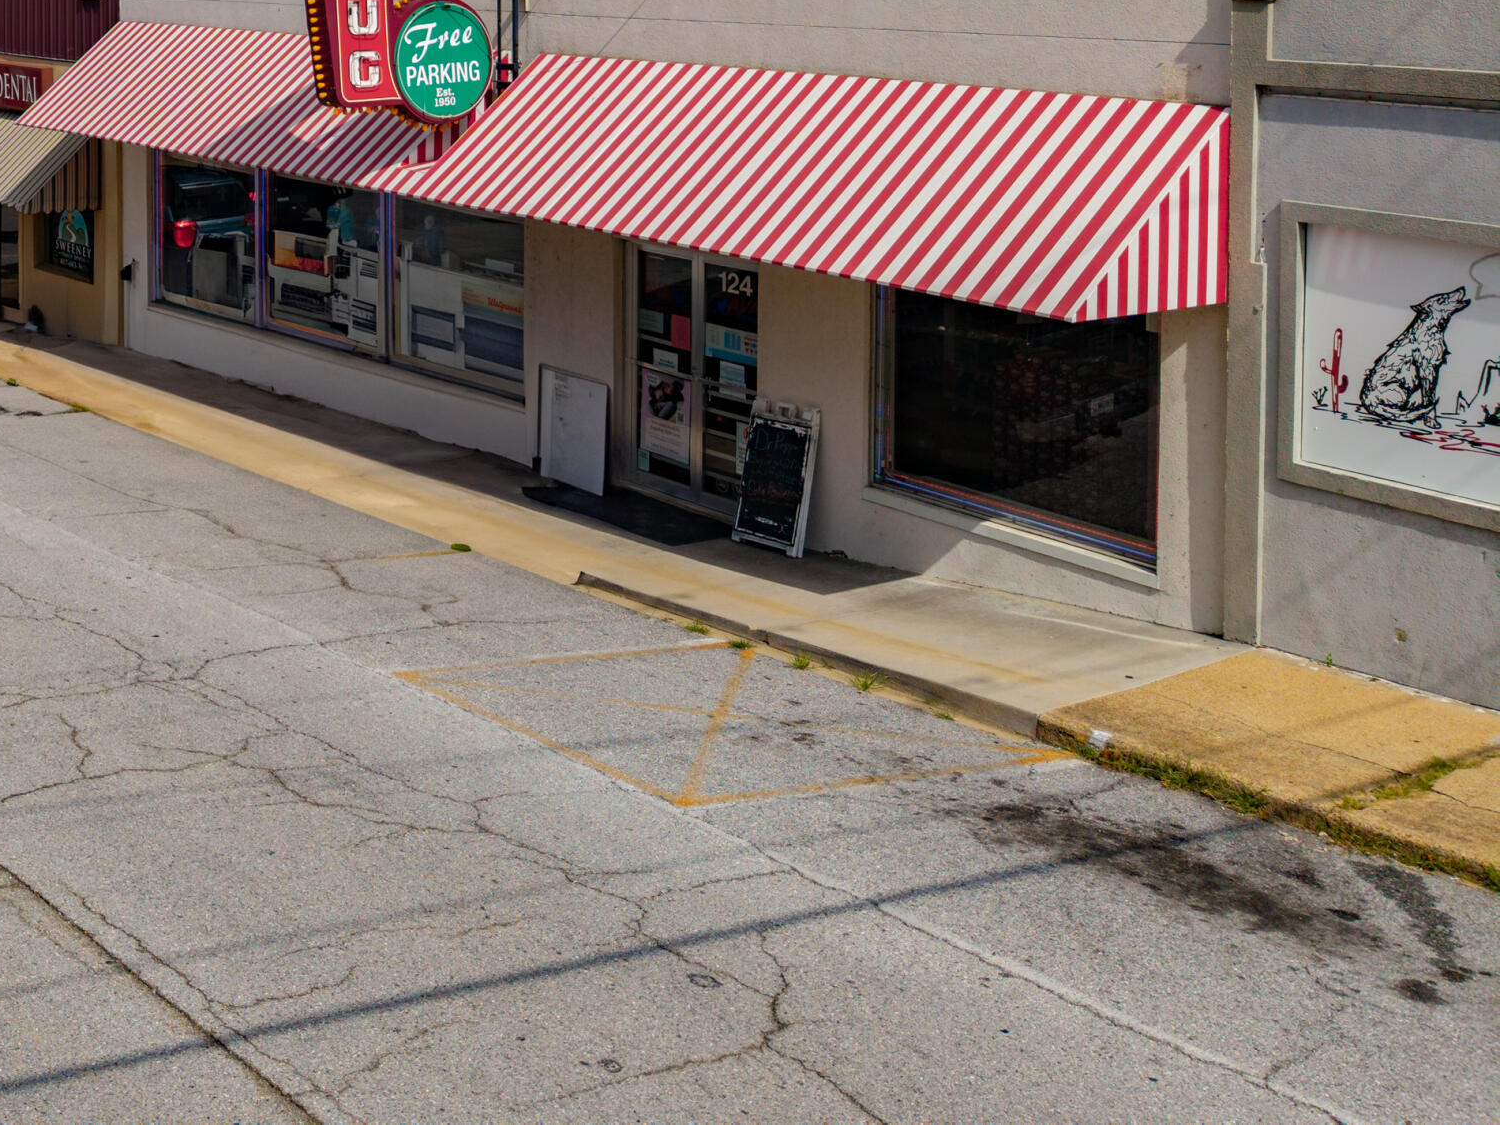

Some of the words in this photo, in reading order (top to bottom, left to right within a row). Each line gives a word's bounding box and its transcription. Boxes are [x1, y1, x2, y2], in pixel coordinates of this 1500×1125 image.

[404, 22, 473, 64] Free
[406, 60, 481, 87] PARKING
[434, 96, 457, 107] 1950
[436, 87, 455, 98] Est.
[55, 240, 92, 259] SWEENEY
[718, 271, 753, 297] 124
